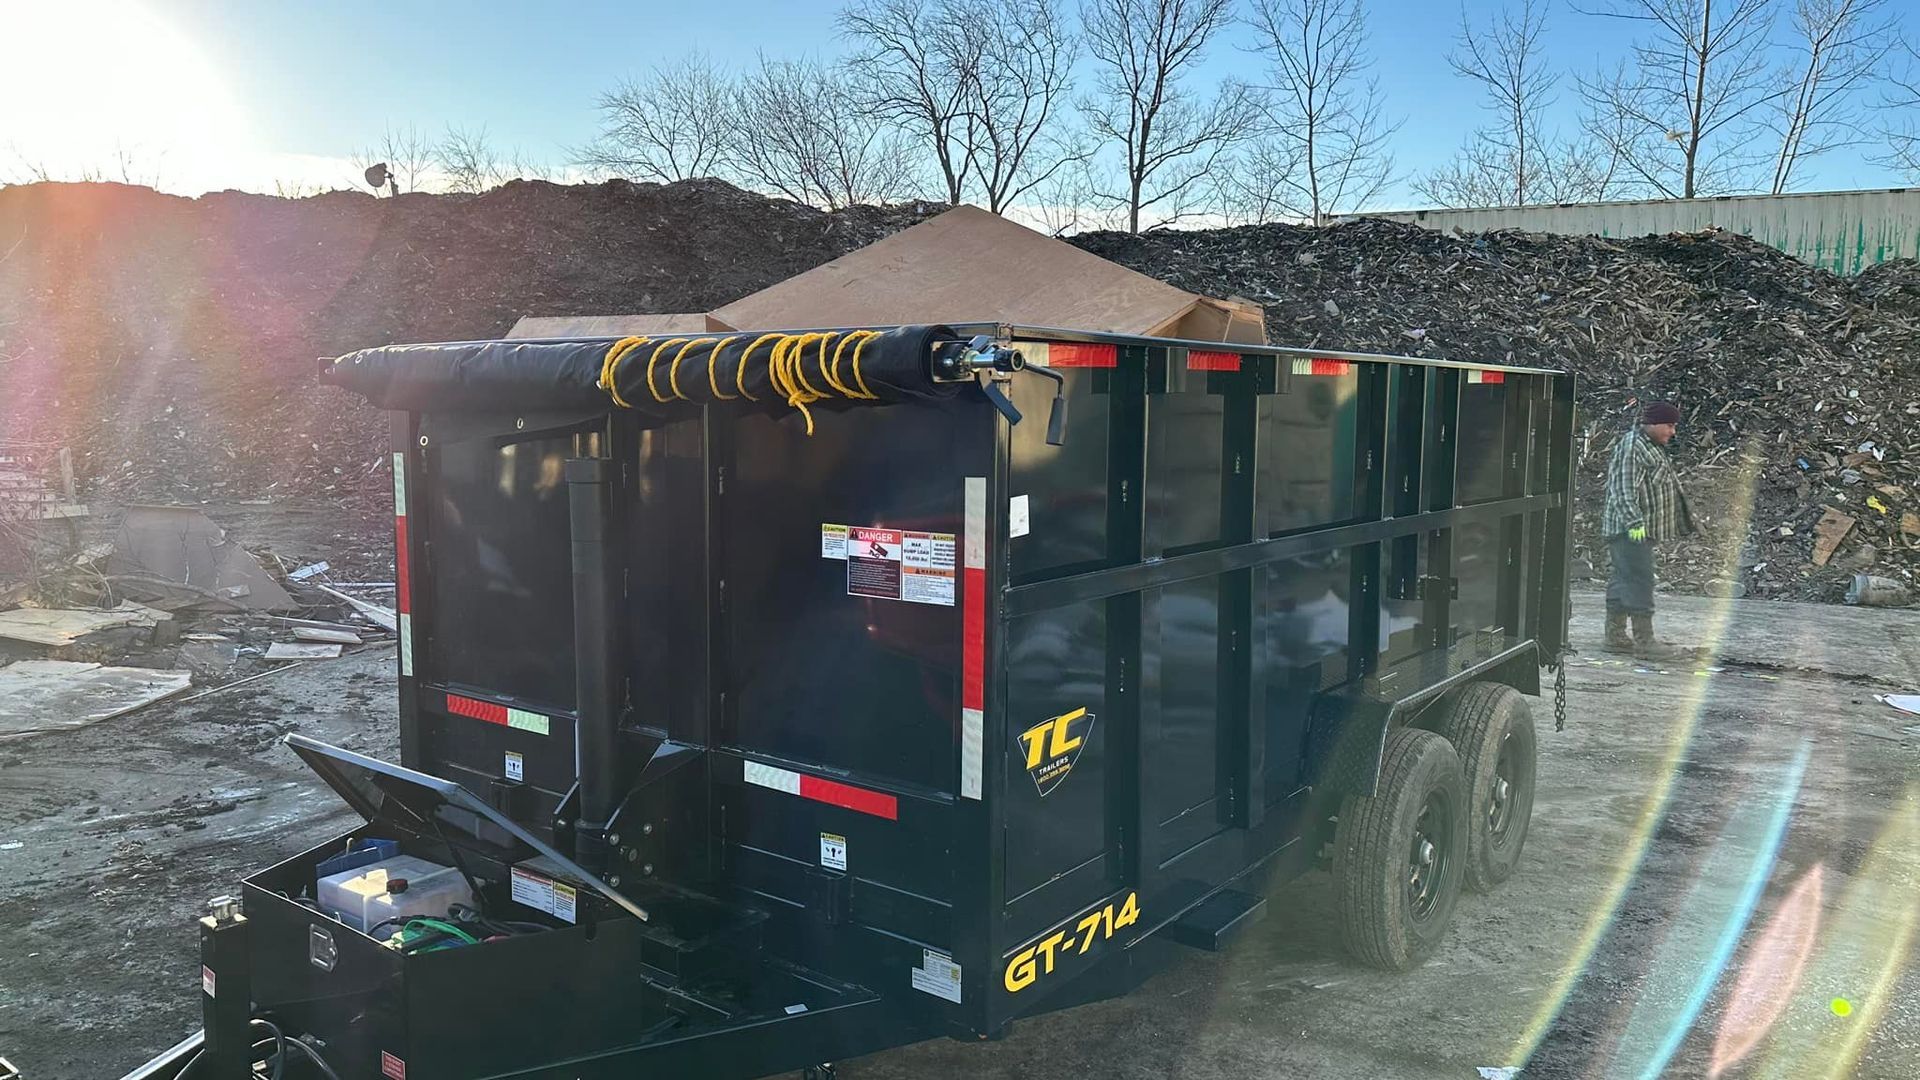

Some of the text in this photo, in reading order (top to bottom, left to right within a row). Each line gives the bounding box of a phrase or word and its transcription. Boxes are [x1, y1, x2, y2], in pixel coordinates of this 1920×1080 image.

[858, 531, 893, 542] DANGER
[1023, 706, 1087, 770] TC
[1038, 755, 1069, 776] TRAILERS
[1004, 892, 1141, 993] GT-714
